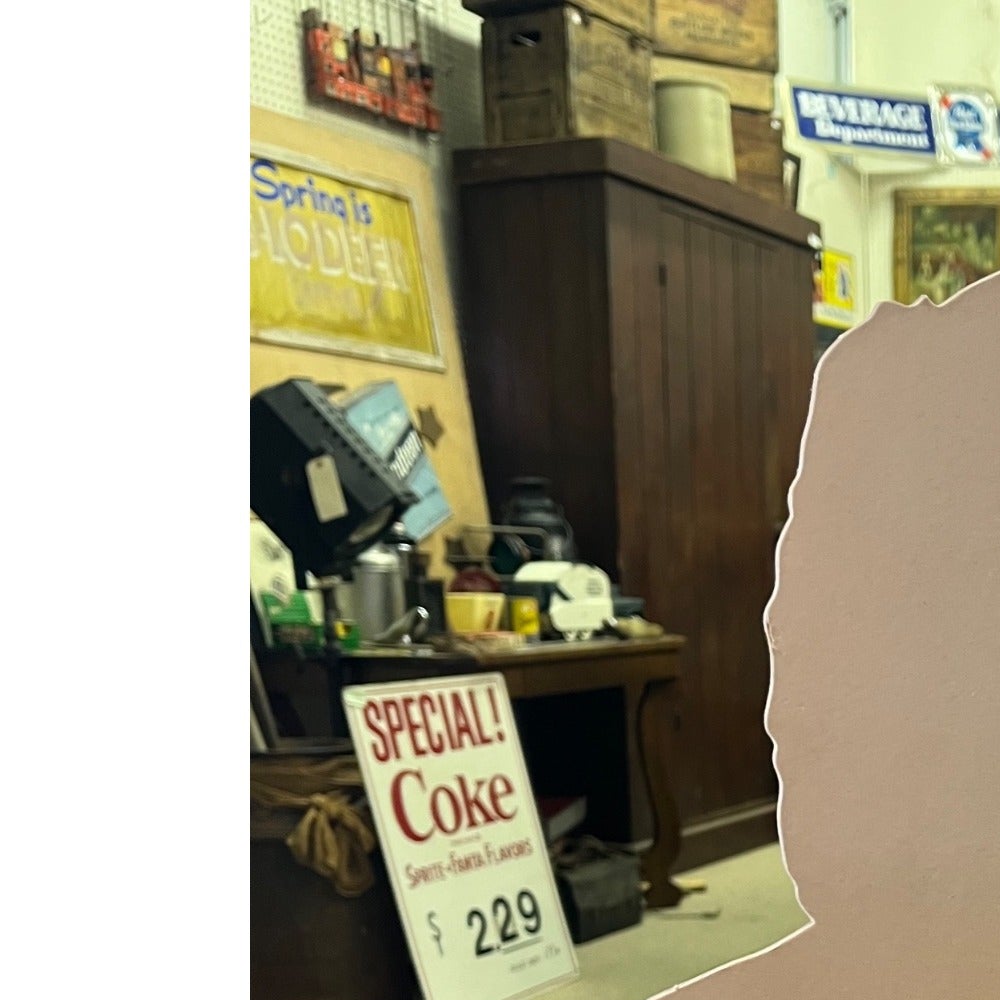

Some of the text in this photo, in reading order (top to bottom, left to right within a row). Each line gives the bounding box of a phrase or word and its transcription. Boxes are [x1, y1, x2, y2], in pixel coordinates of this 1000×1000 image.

[797, 91, 928, 131] BEVERAGE
[815, 117, 930, 149] Department
[251, 158, 372, 226] Spring is
[364, 687, 506, 763] SPECIAL!
[391, 768, 518, 845] Coke
